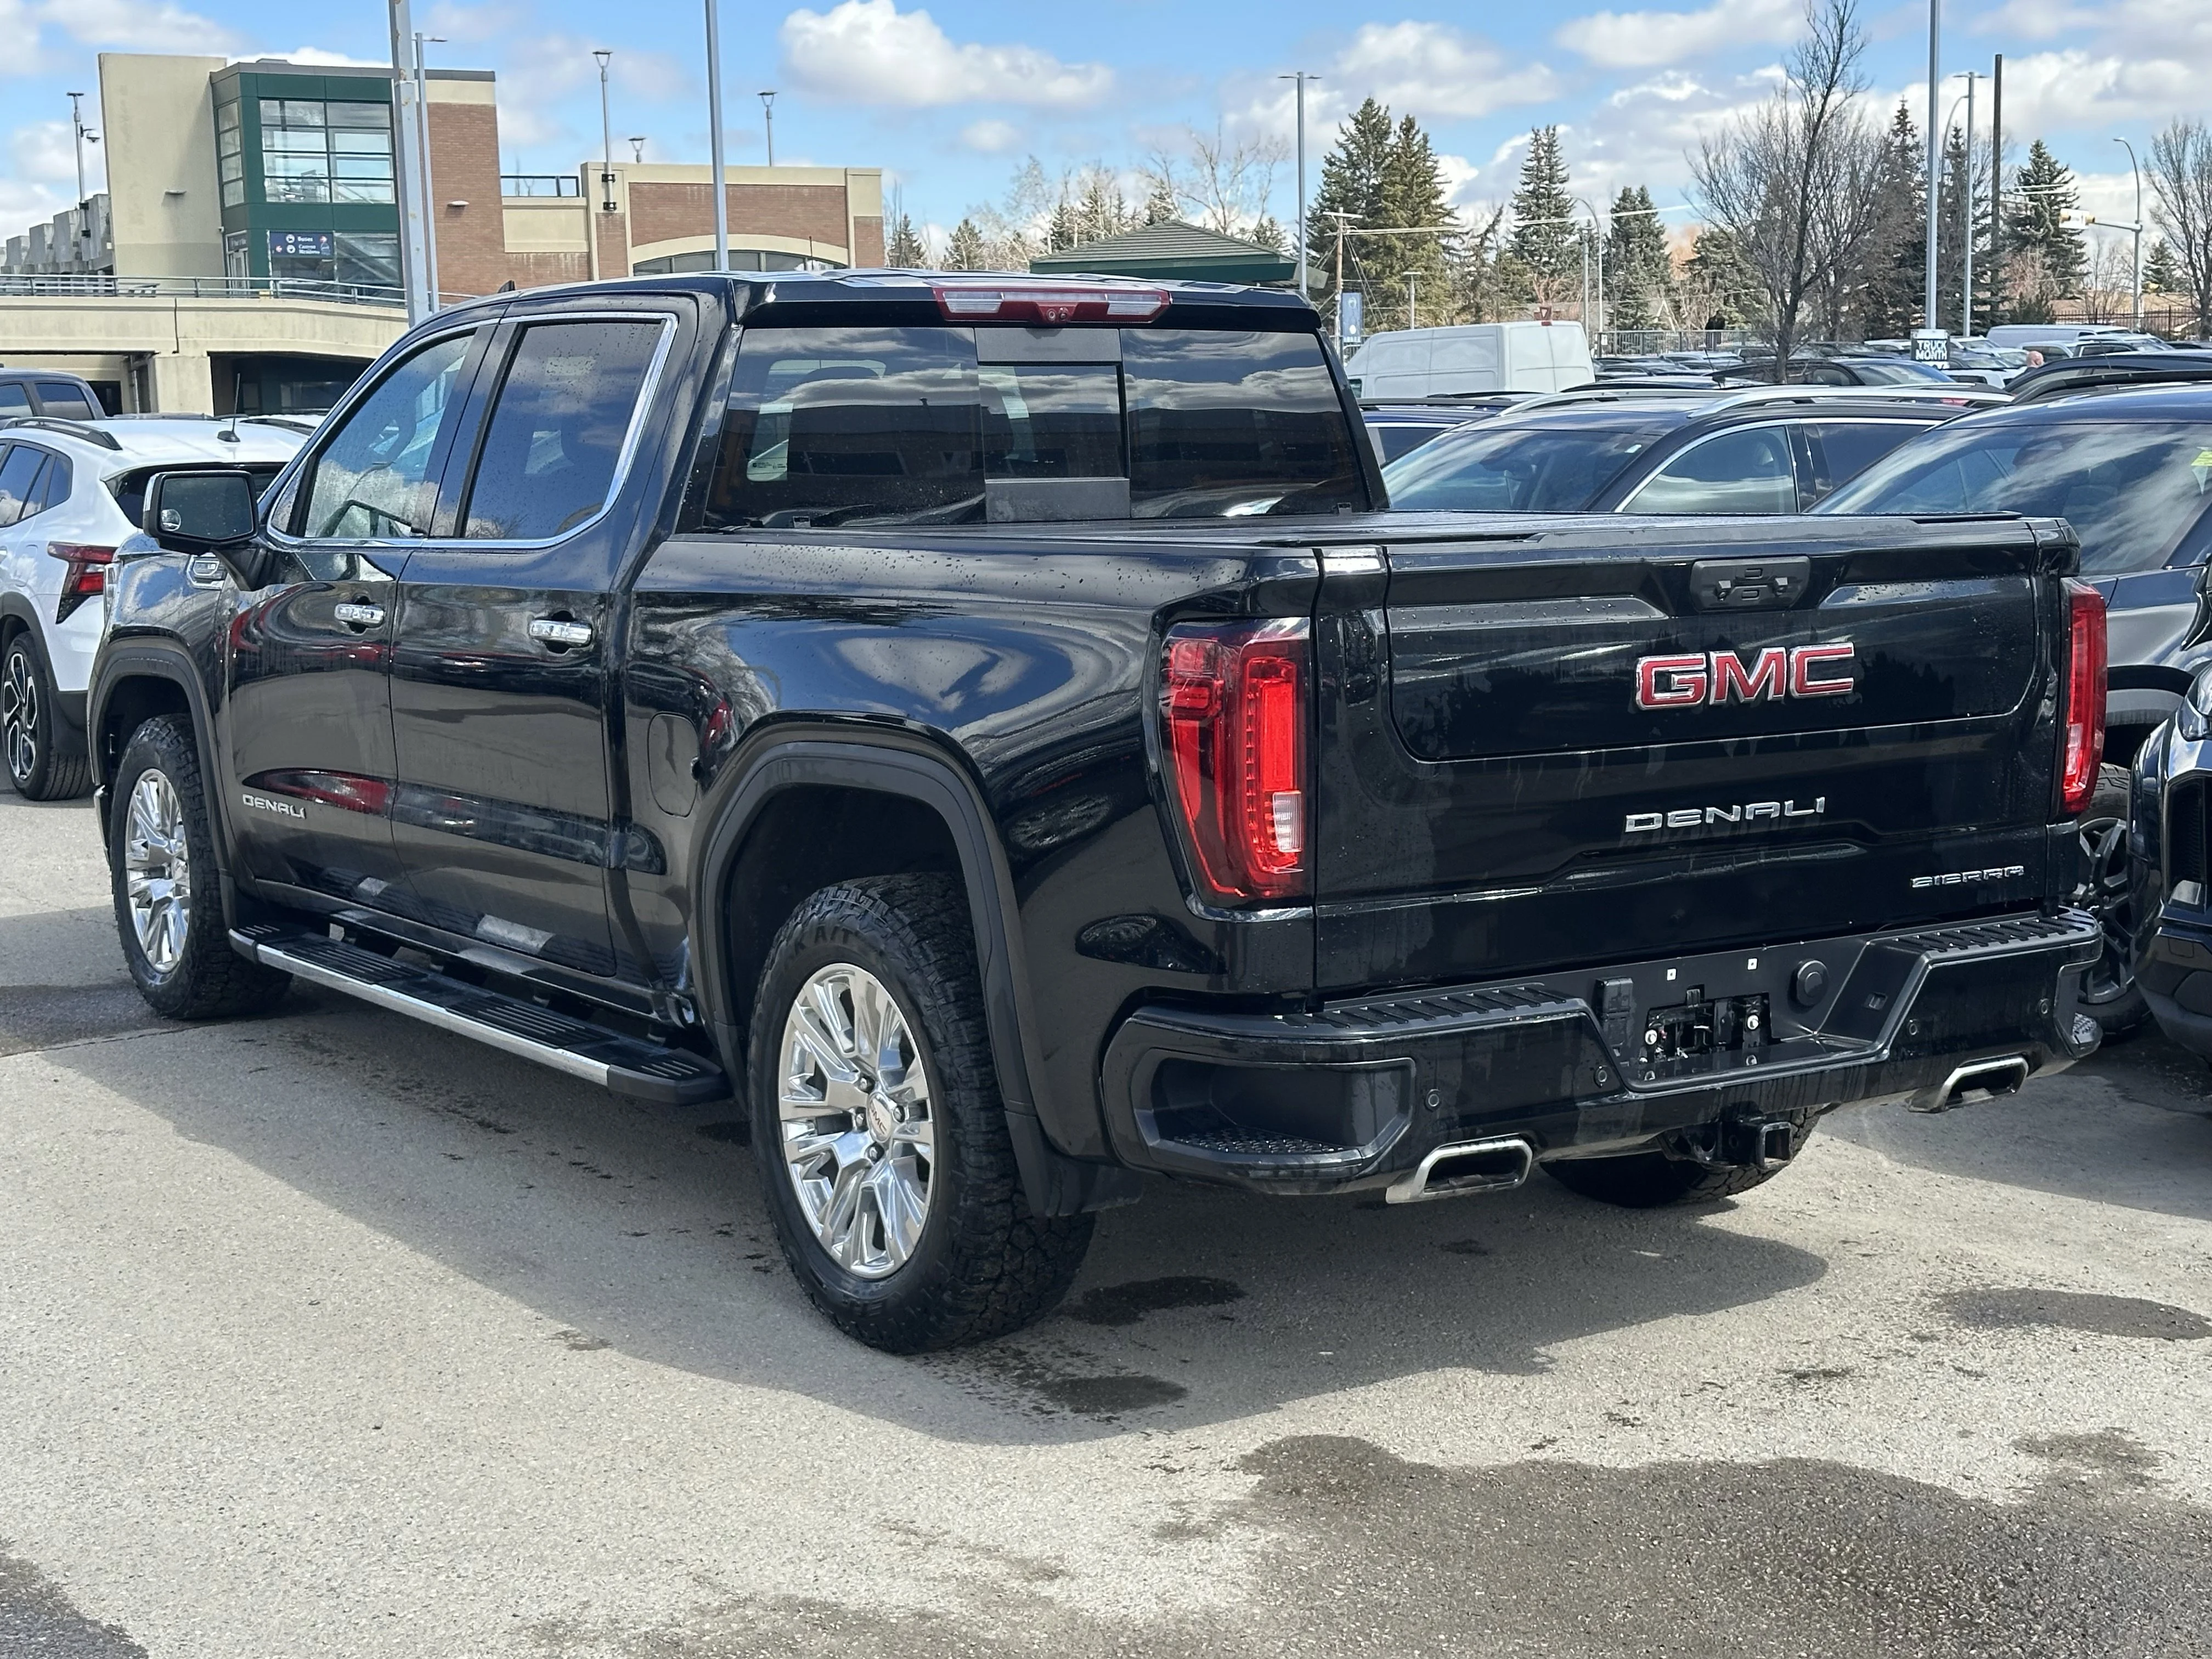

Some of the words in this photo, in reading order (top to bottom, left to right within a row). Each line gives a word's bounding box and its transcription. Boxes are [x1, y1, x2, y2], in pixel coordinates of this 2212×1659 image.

[1915, 349, 1947, 360] MONTH
[1916, 340, 1947, 350] TRUCK
[1635, 642, 1855, 710] GMC
[242, 794, 306, 819] DENALI
[1624, 797, 1825, 833] DENALI
[1911, 865, 2024, 888] SIERRA
